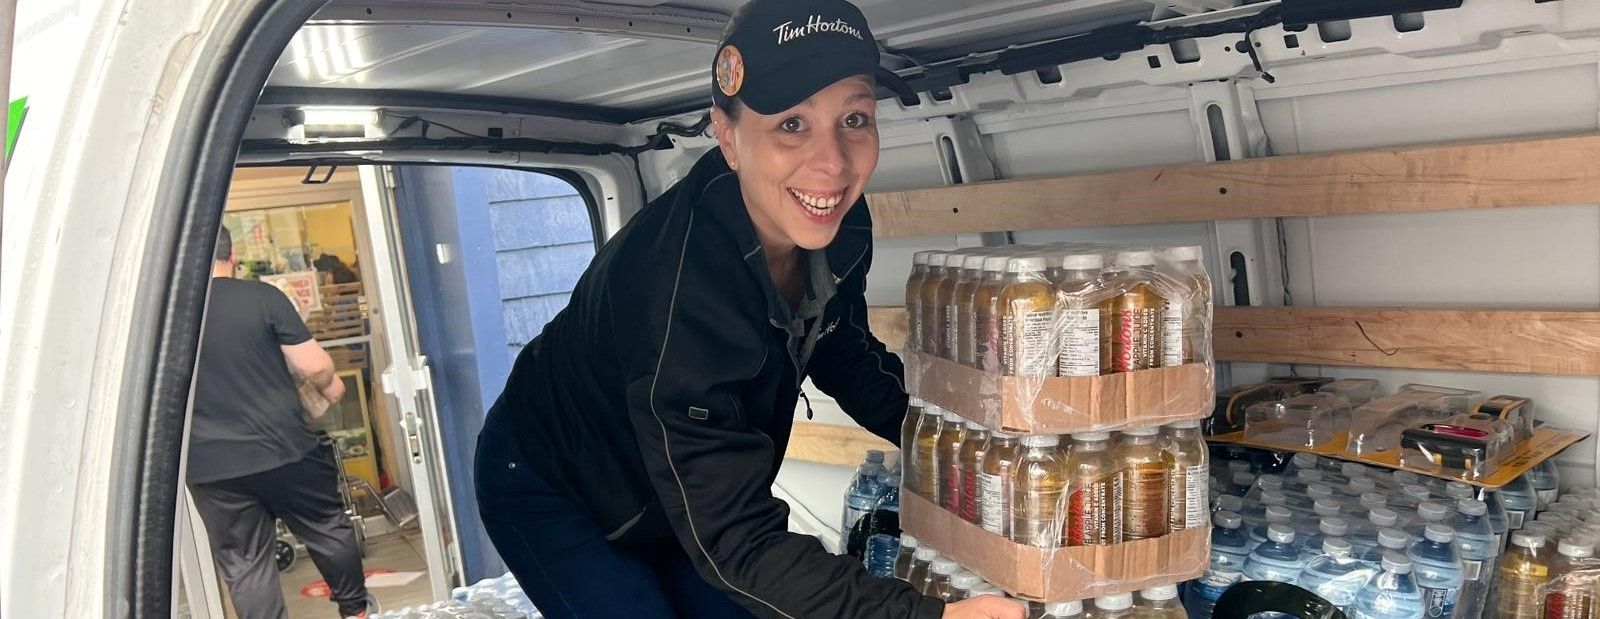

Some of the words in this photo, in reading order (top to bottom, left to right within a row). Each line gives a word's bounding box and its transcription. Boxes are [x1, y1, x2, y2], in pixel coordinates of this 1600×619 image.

[773, 21, 805, 44] Tim
[806, 15, 864, 40] Hortons
[1133, 308, 1142, 335] JUICE
[1133, 337, 1142, 366] APPLE
[1084, 482, 1093, 508] JUICE
[1084, 510, 1093, 536] APPLE
